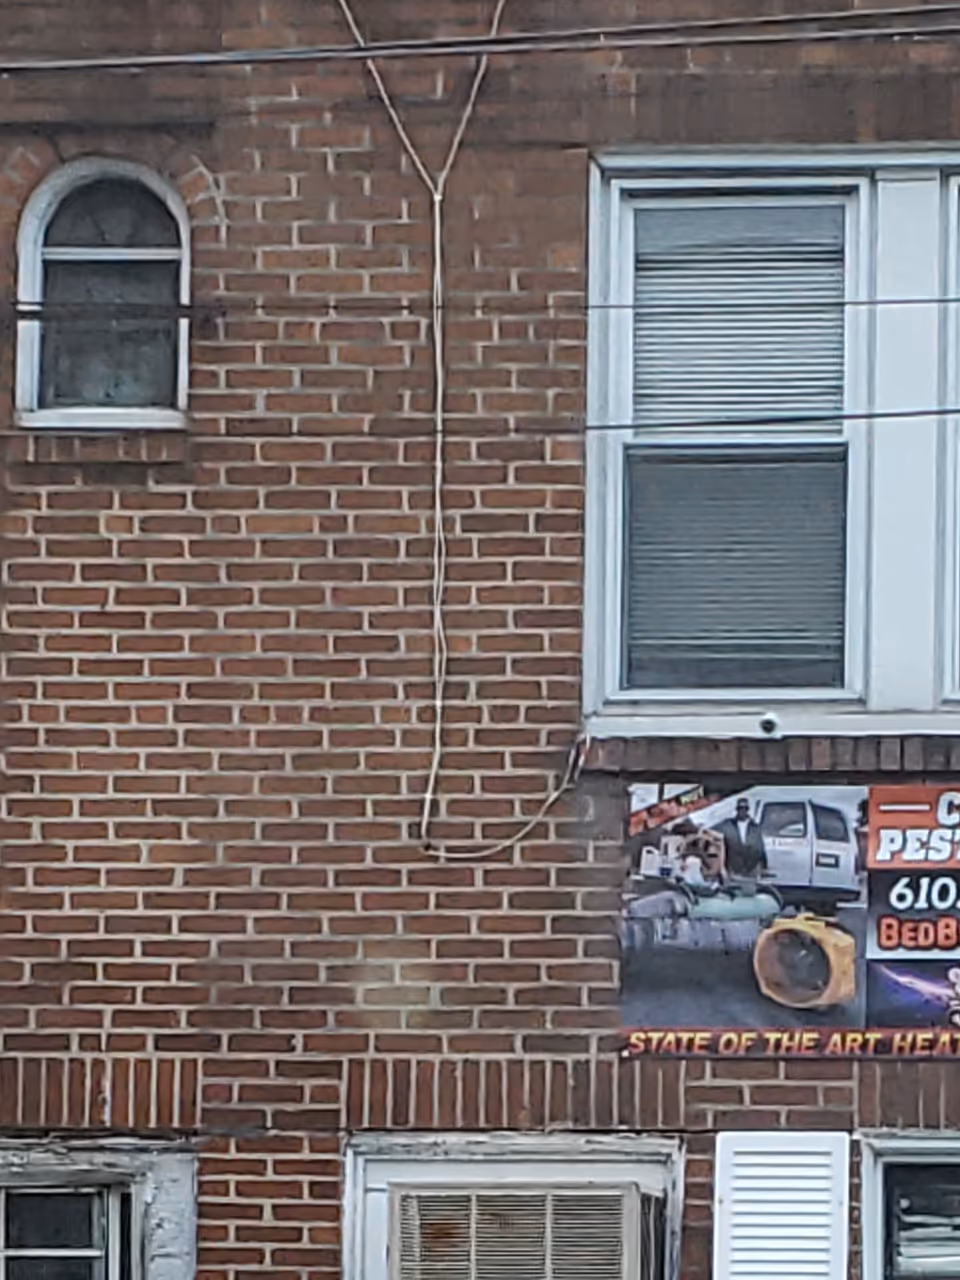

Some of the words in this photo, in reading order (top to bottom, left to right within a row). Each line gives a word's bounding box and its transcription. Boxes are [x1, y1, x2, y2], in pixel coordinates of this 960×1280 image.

[628, 1031, 713, 1055] STATE
[717, 1032, 758, 1055] OF
[763, 1032, 819, 1055] THE
[824, 1032, 882, 1055] ART
